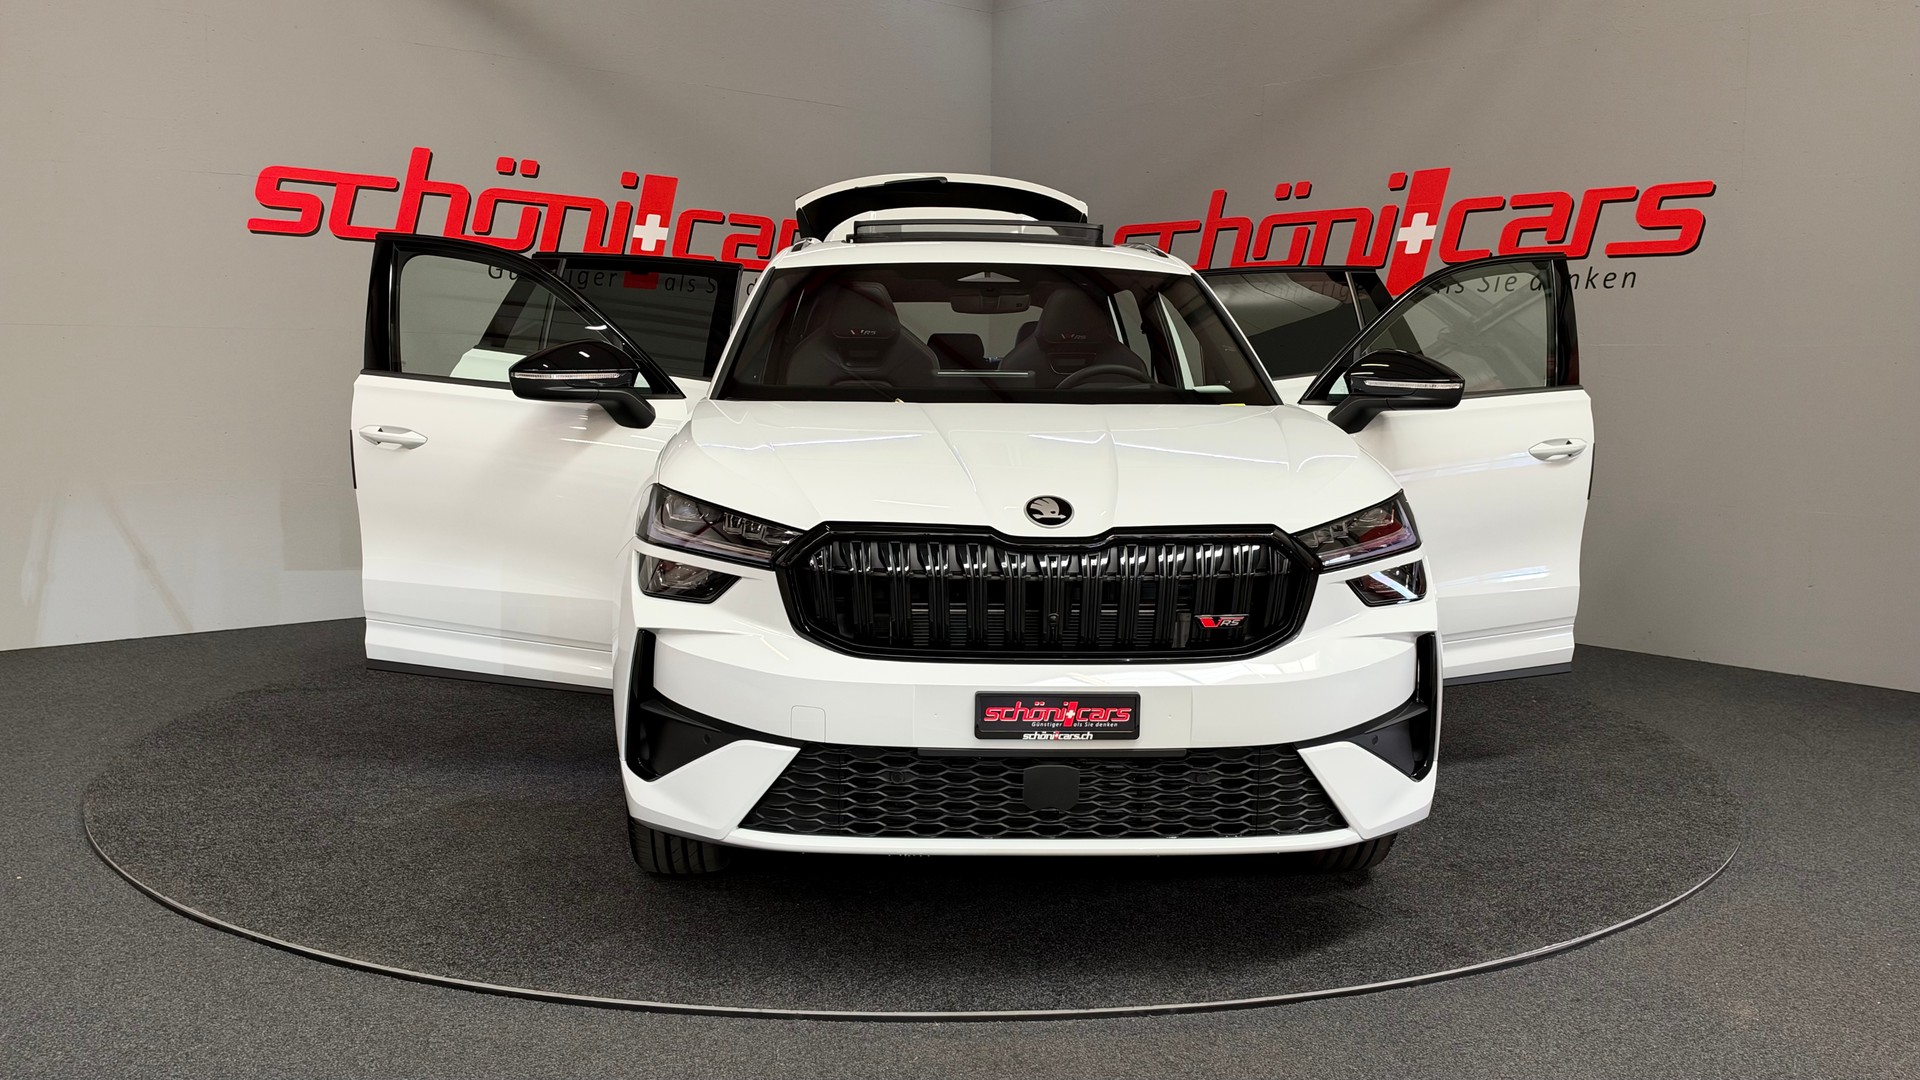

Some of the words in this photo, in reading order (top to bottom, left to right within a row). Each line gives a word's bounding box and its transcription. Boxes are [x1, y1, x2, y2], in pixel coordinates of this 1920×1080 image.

[664, 273, 696, 293] als
[1530, 266, 1638, 291] dnken
[1031, 720, 1063, 728] Günstiger
